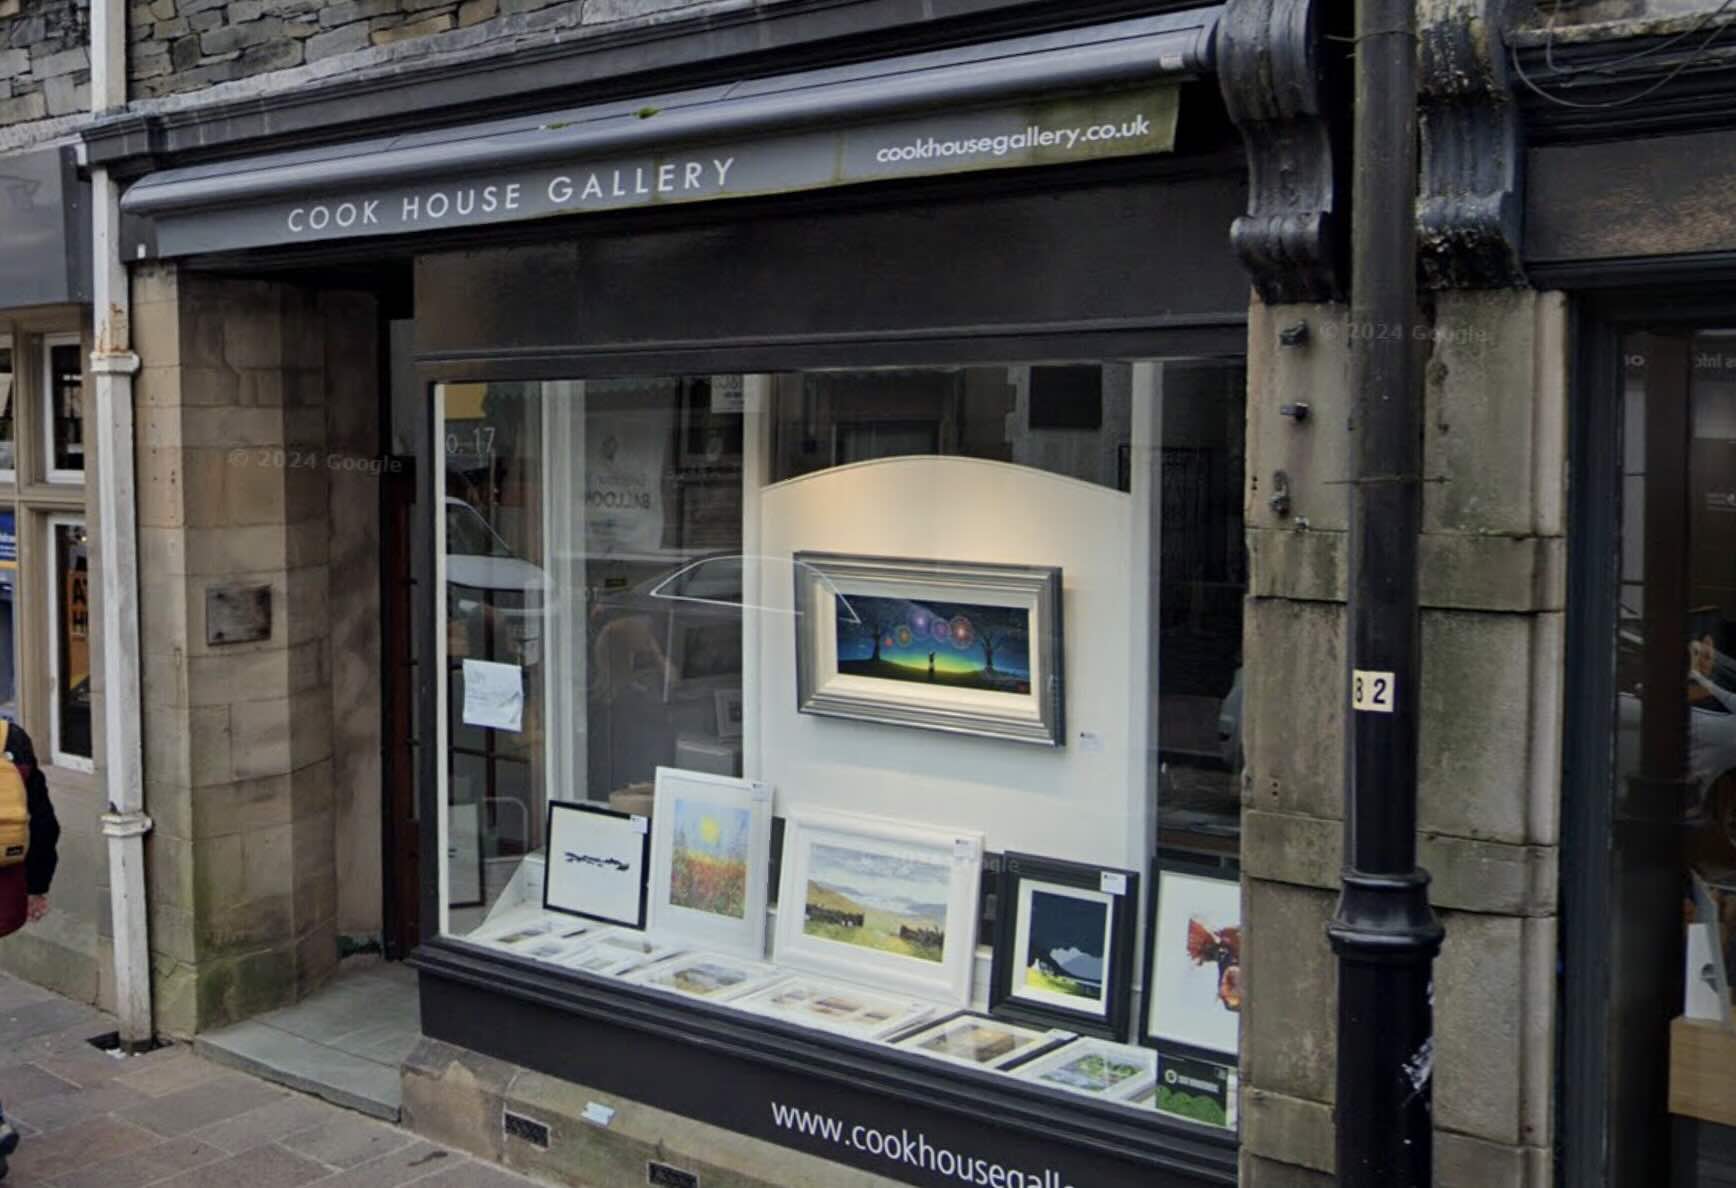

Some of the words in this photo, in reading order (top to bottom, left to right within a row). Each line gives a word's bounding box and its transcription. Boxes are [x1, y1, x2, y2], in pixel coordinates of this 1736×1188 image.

[876, 114, 1151, 162] cookhousegallery.co.uk
[287, 199, 380, 232] COOK
[401, 183, 521, 220] HOUSE
[547, 156, 736, 202] GALLERY
[770, 1101, 1077, 1188] www.cookhousegall
